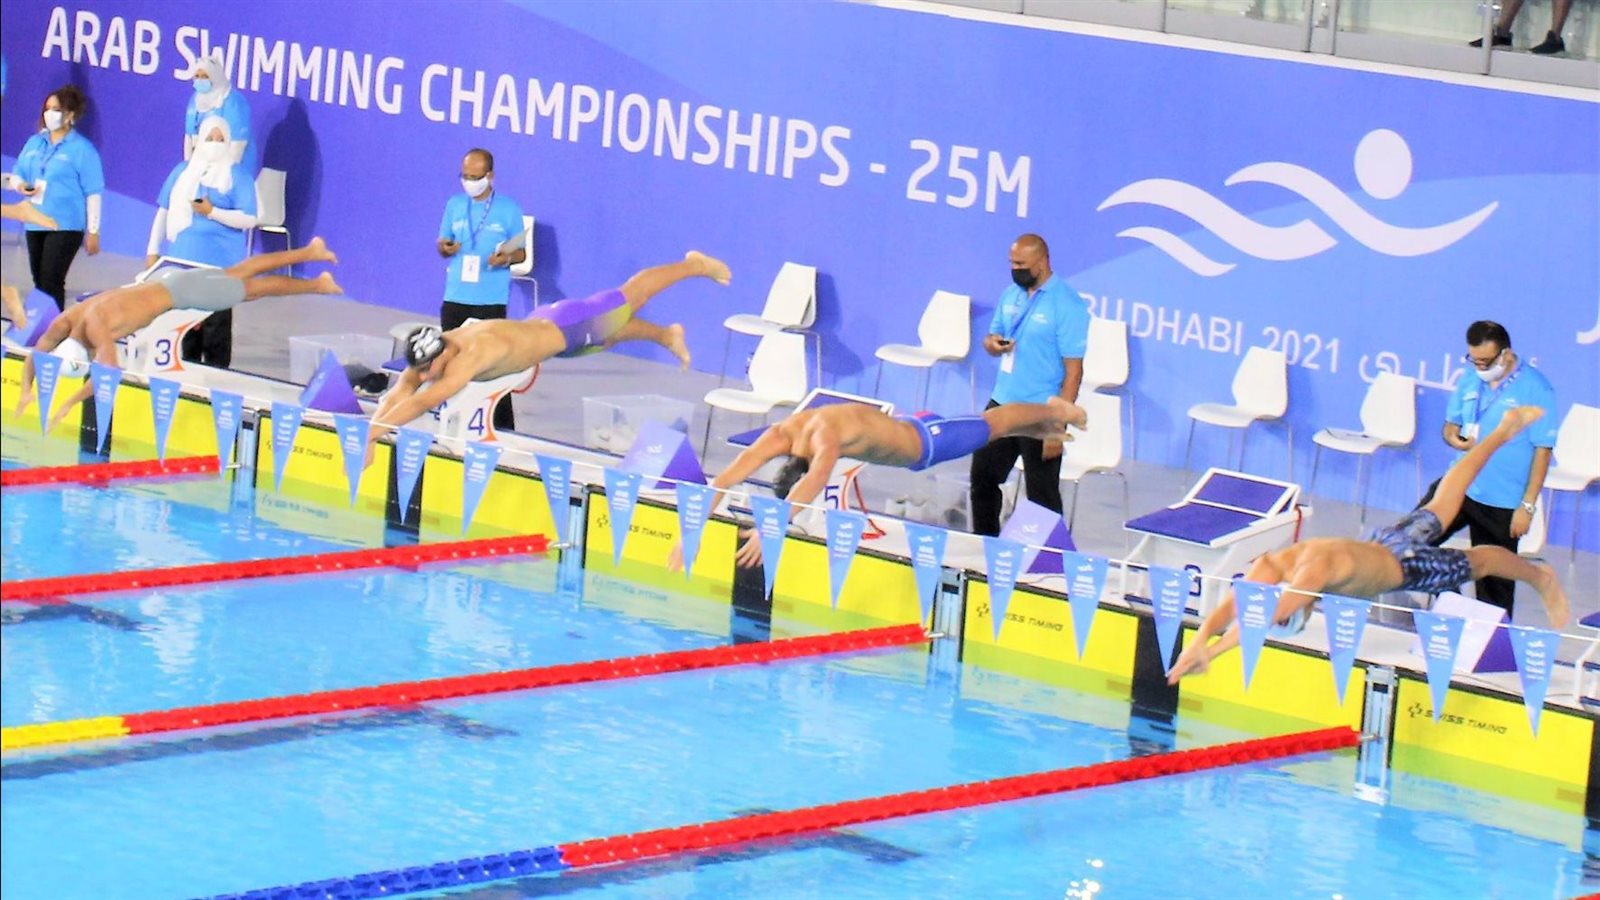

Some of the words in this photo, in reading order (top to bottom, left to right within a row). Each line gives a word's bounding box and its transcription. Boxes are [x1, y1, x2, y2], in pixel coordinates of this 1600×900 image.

[41, 6, 161, 75] ARAB
[173, 25, 404, 116] SWIMMING
[419, 63, 852, 187] CHAMPIONSHIPS
[906, 139, 1031, 218] 25M
[154, 338, 171, 366] 3
[1131, 301, 1243, 354] DHABI
[1262, 325, 1339, 374] 2021
[467, 407, 484, 436] 4
[824, 485, 839, 510] 5
